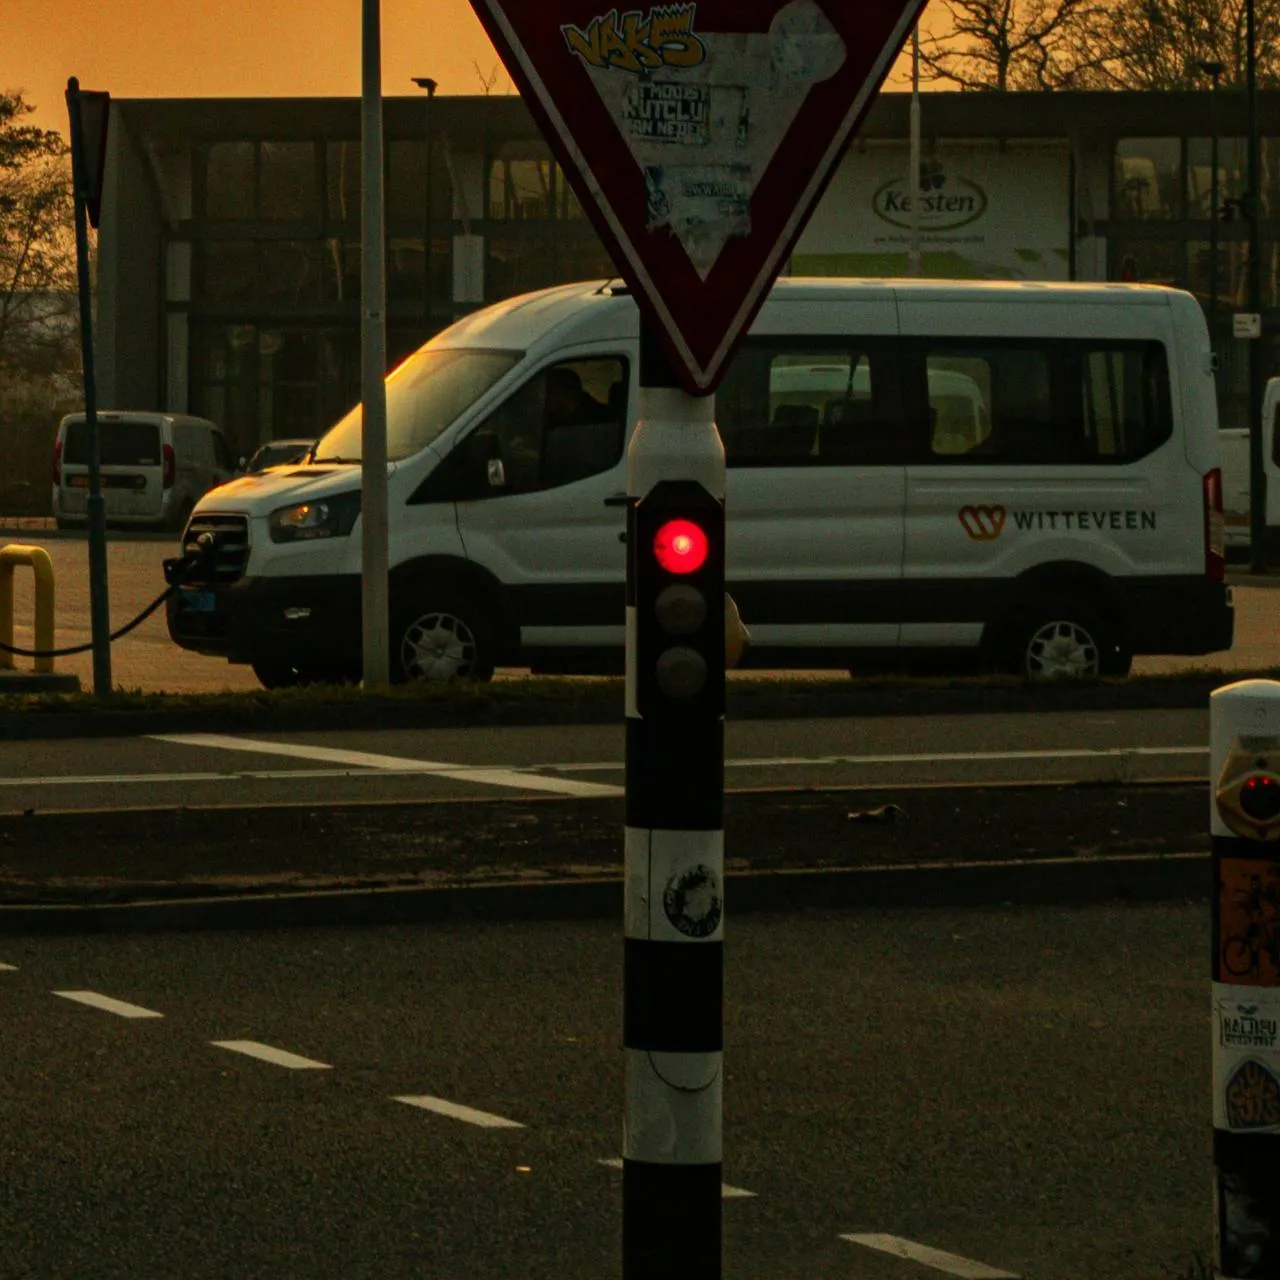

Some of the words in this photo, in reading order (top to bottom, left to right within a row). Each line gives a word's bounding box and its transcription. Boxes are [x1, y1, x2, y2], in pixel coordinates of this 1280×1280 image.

[623, 95, 707, 121] KUTCLU
[884, 190, 974, 212] Kesten
[1014, 510, 1157, 530] WITTEVEEN
